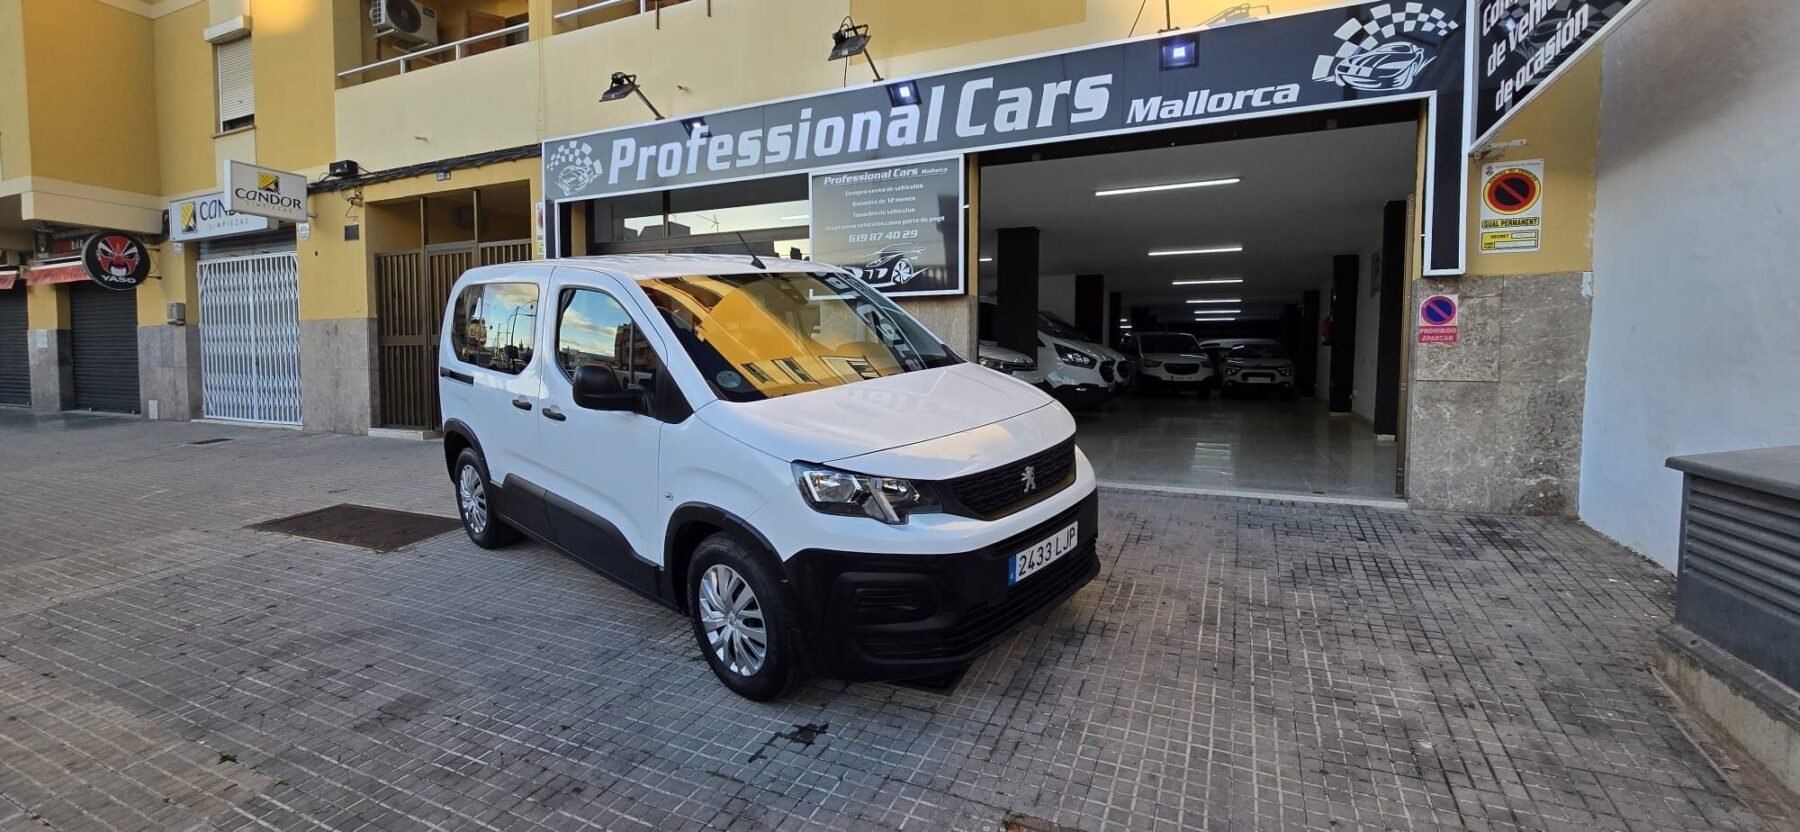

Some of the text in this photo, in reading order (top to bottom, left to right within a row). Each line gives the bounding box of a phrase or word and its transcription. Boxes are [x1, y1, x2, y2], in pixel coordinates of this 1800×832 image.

[1488, 39, 1506, 77] de
[1495, 3, 1589, 111] de ocasión
[608, 73, 1301, 185] Professional Cars Mallorca
[823, 169, 892, 186] Professional
[893, 168, 918, 177] Cars
[849, 229, 918, 243] 619 87 40 29
[1483, 218, 1537, 228] GUAL PERMANENT
[101, 274, 137, 284] YASO
[1018, 526, 1076, 576] 2433 LJP
